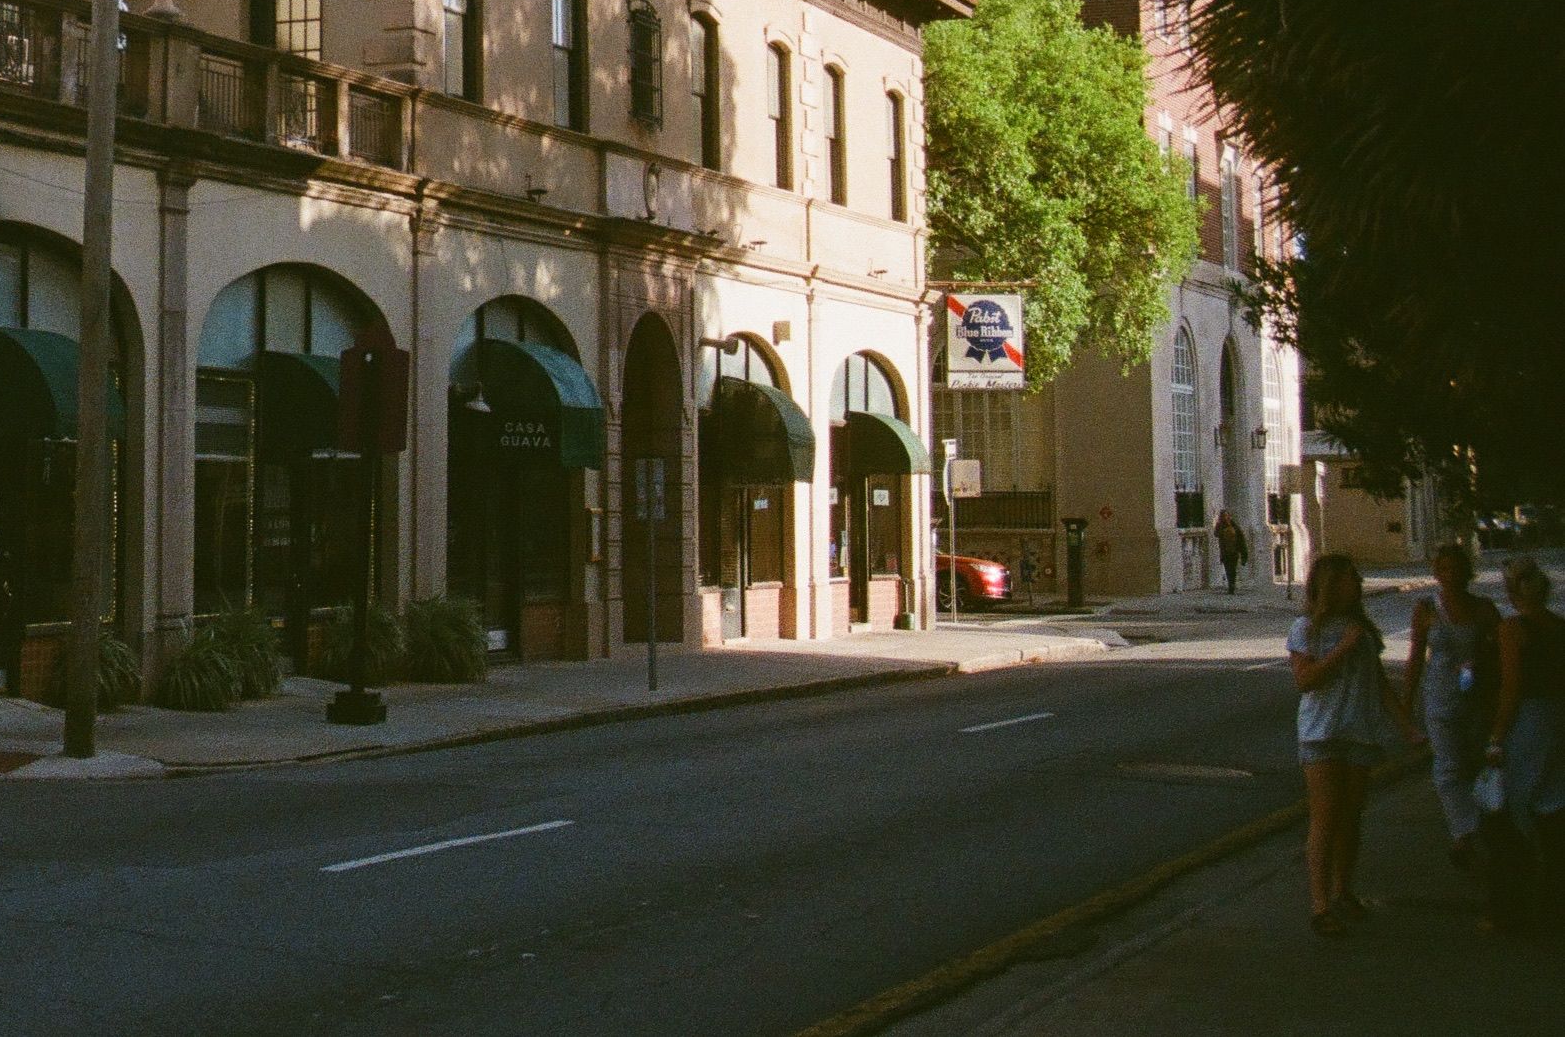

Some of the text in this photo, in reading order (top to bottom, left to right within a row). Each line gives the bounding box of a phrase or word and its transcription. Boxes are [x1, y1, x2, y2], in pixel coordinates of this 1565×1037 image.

[968, 307, 1001, 323] Pabst
[958, 326, 1013, 338] Blue Ribbon
[505, 422, 545, 434] CASA
[500, 436, 551, 448] GUAVA
